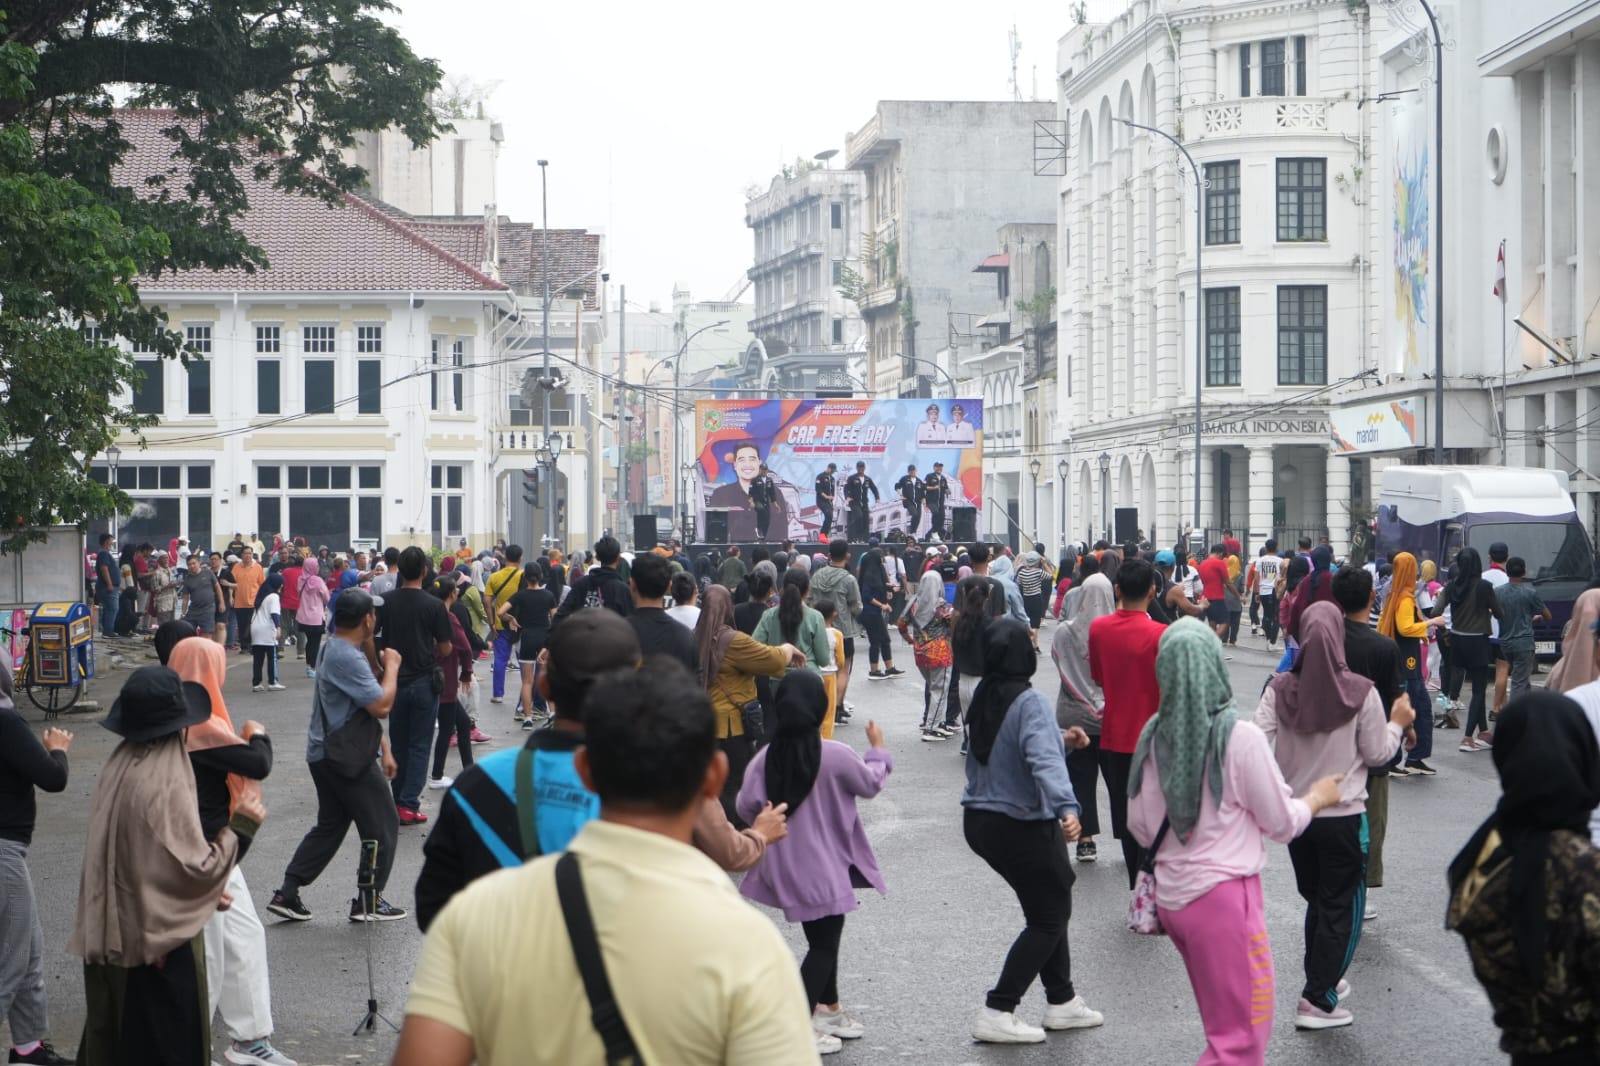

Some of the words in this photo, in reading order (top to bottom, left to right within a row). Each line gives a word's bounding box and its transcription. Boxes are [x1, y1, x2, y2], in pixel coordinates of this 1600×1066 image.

[787, 425, 817, 445] CAR
[821, 425, 861, 445] FREE
[864, 424, 896, 445] DAY
[1252, 420, 1328, 434] INDONESIA
[1356, 424, 1379, 445] mandiri
